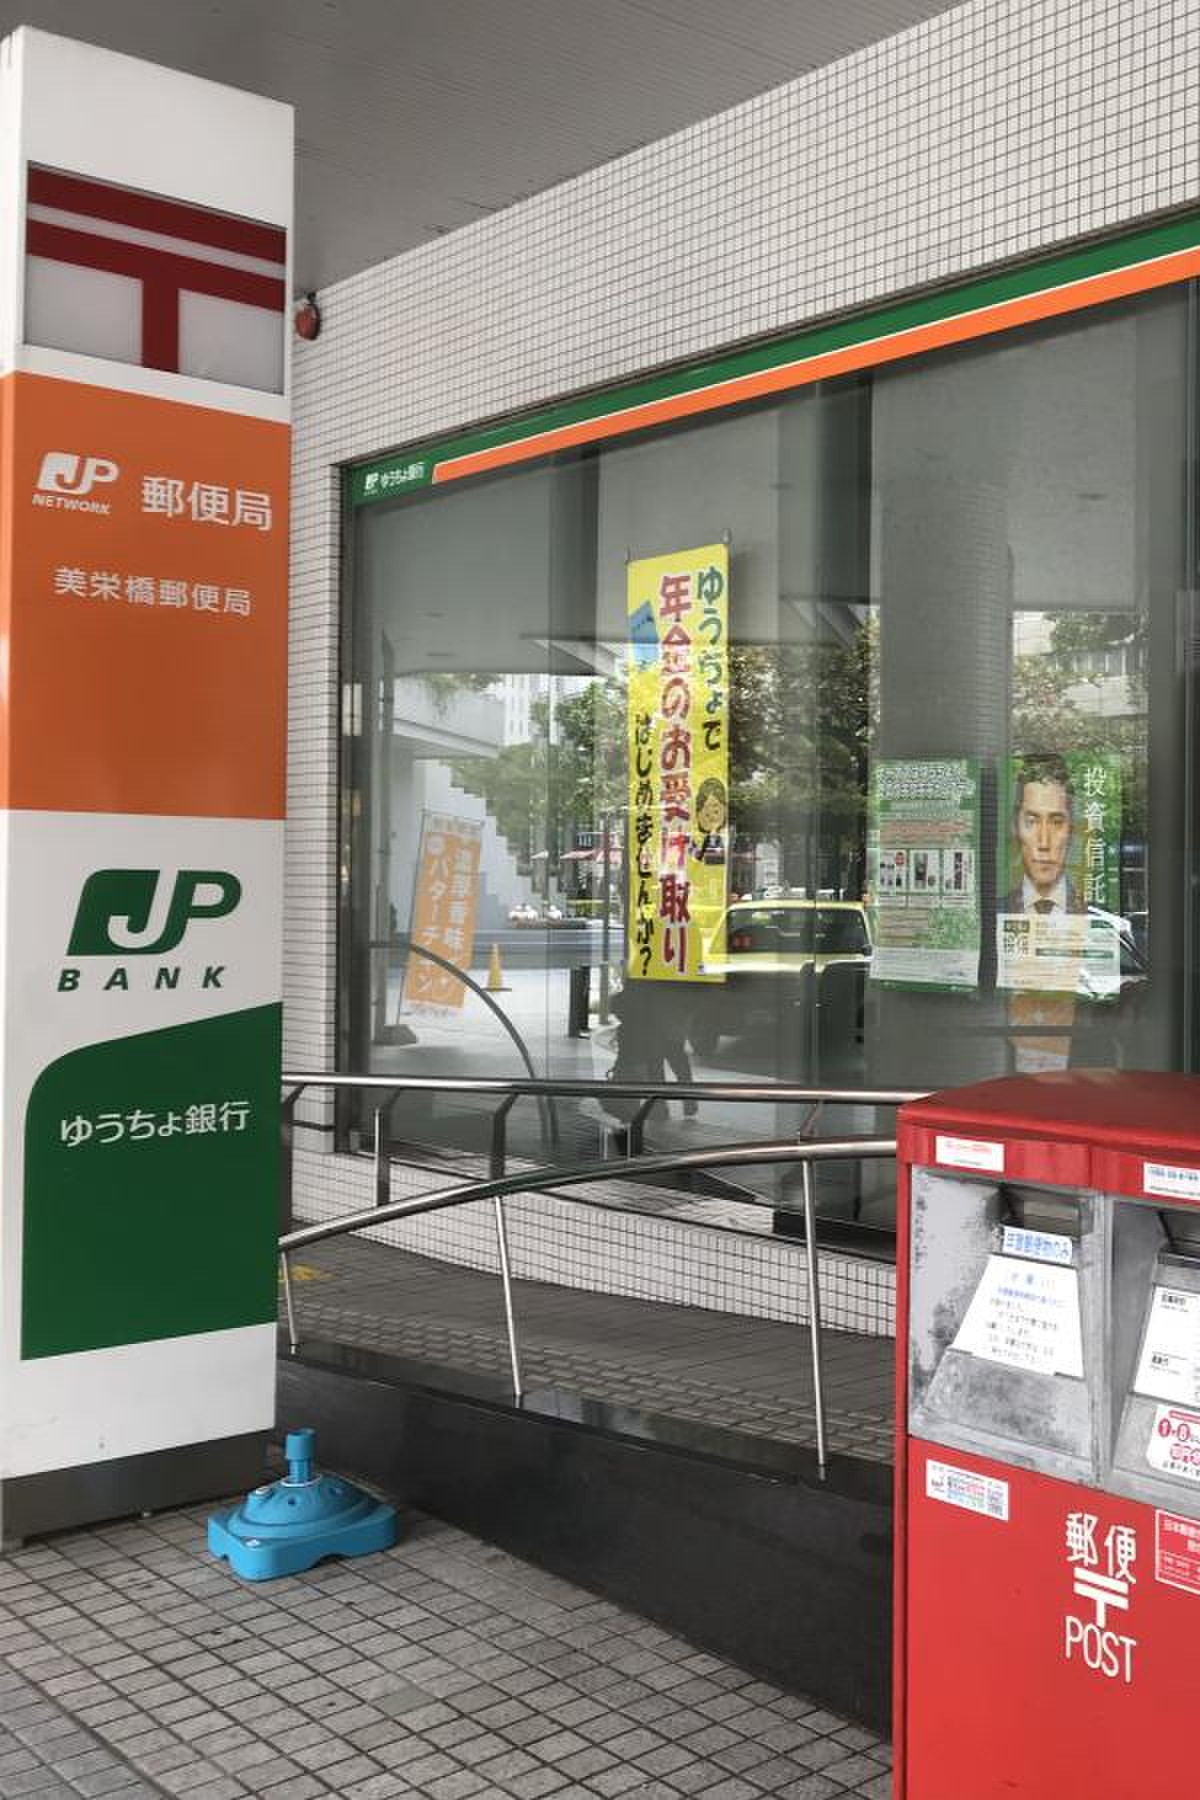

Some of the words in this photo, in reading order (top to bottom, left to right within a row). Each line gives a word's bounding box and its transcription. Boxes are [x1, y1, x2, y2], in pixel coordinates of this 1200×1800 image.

[32, 494, 111, 513] NETWORK
[141, 474, 272, 531] 郵便局
[53, 565, 252, 617] 美栄橋郵便局
[697, 567, 725, 751] ゆうちょで
[659, 574, 692, 974] 年金のお受け取り
[57, 966, 225, 992] BANK
[59, 1101, 250, 1147] ゆうちょ銀行
[1065, 1512, 1136, 1584] 郵便
[1065, 1615, 1136, 1683] POST
